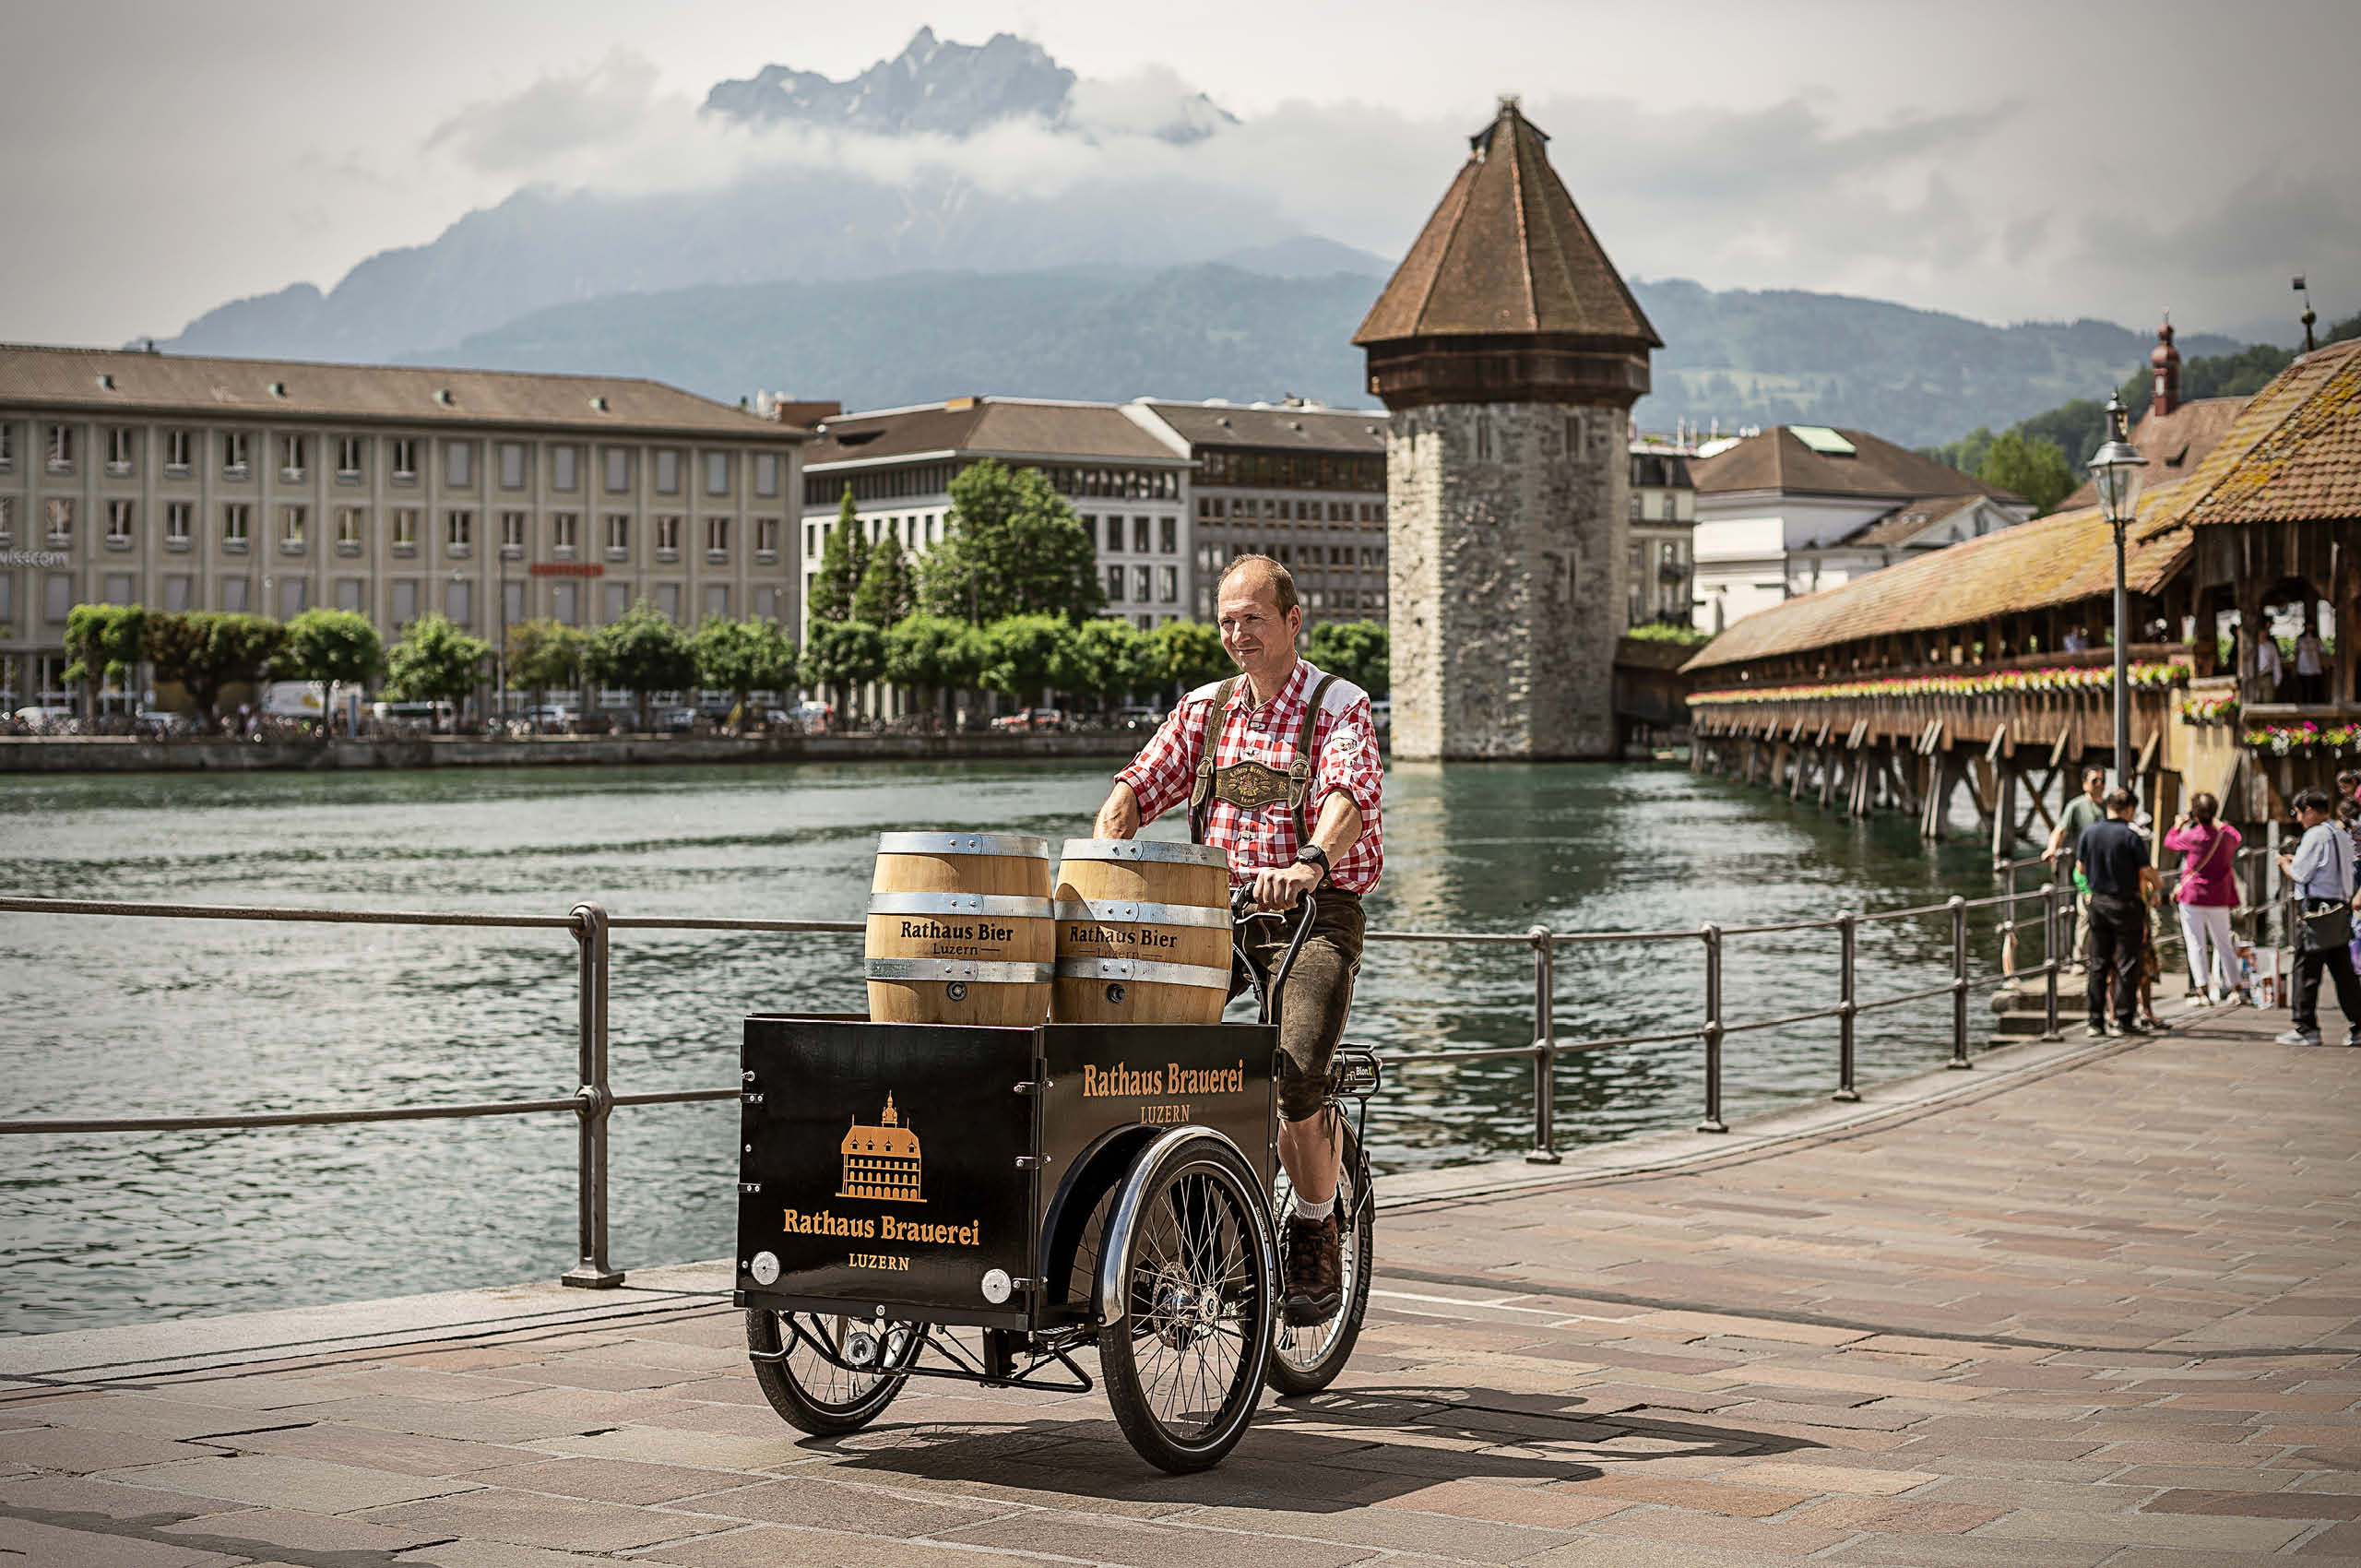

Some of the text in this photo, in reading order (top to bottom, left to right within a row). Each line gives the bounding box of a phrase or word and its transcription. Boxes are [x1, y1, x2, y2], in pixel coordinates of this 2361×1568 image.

[900, 921, 1014, 941] Rathaus Bier
[1070, 925, 1177, 948] Rathaus Bier
[932, 943, 979, 956] Luzern
[1097, 947, 1139, 959] Luzern
[1083, 1059, 1243, 1098] Rathaus Brauerei
[1140, 1104, 1191, 1124] LUZERN
[783, 1208, 980, 1246] Rathaus Brauerei
[848, 1253, 910, 1272] LUZERN
[1352, 1210, 1370, 1324] SCHWALBE
